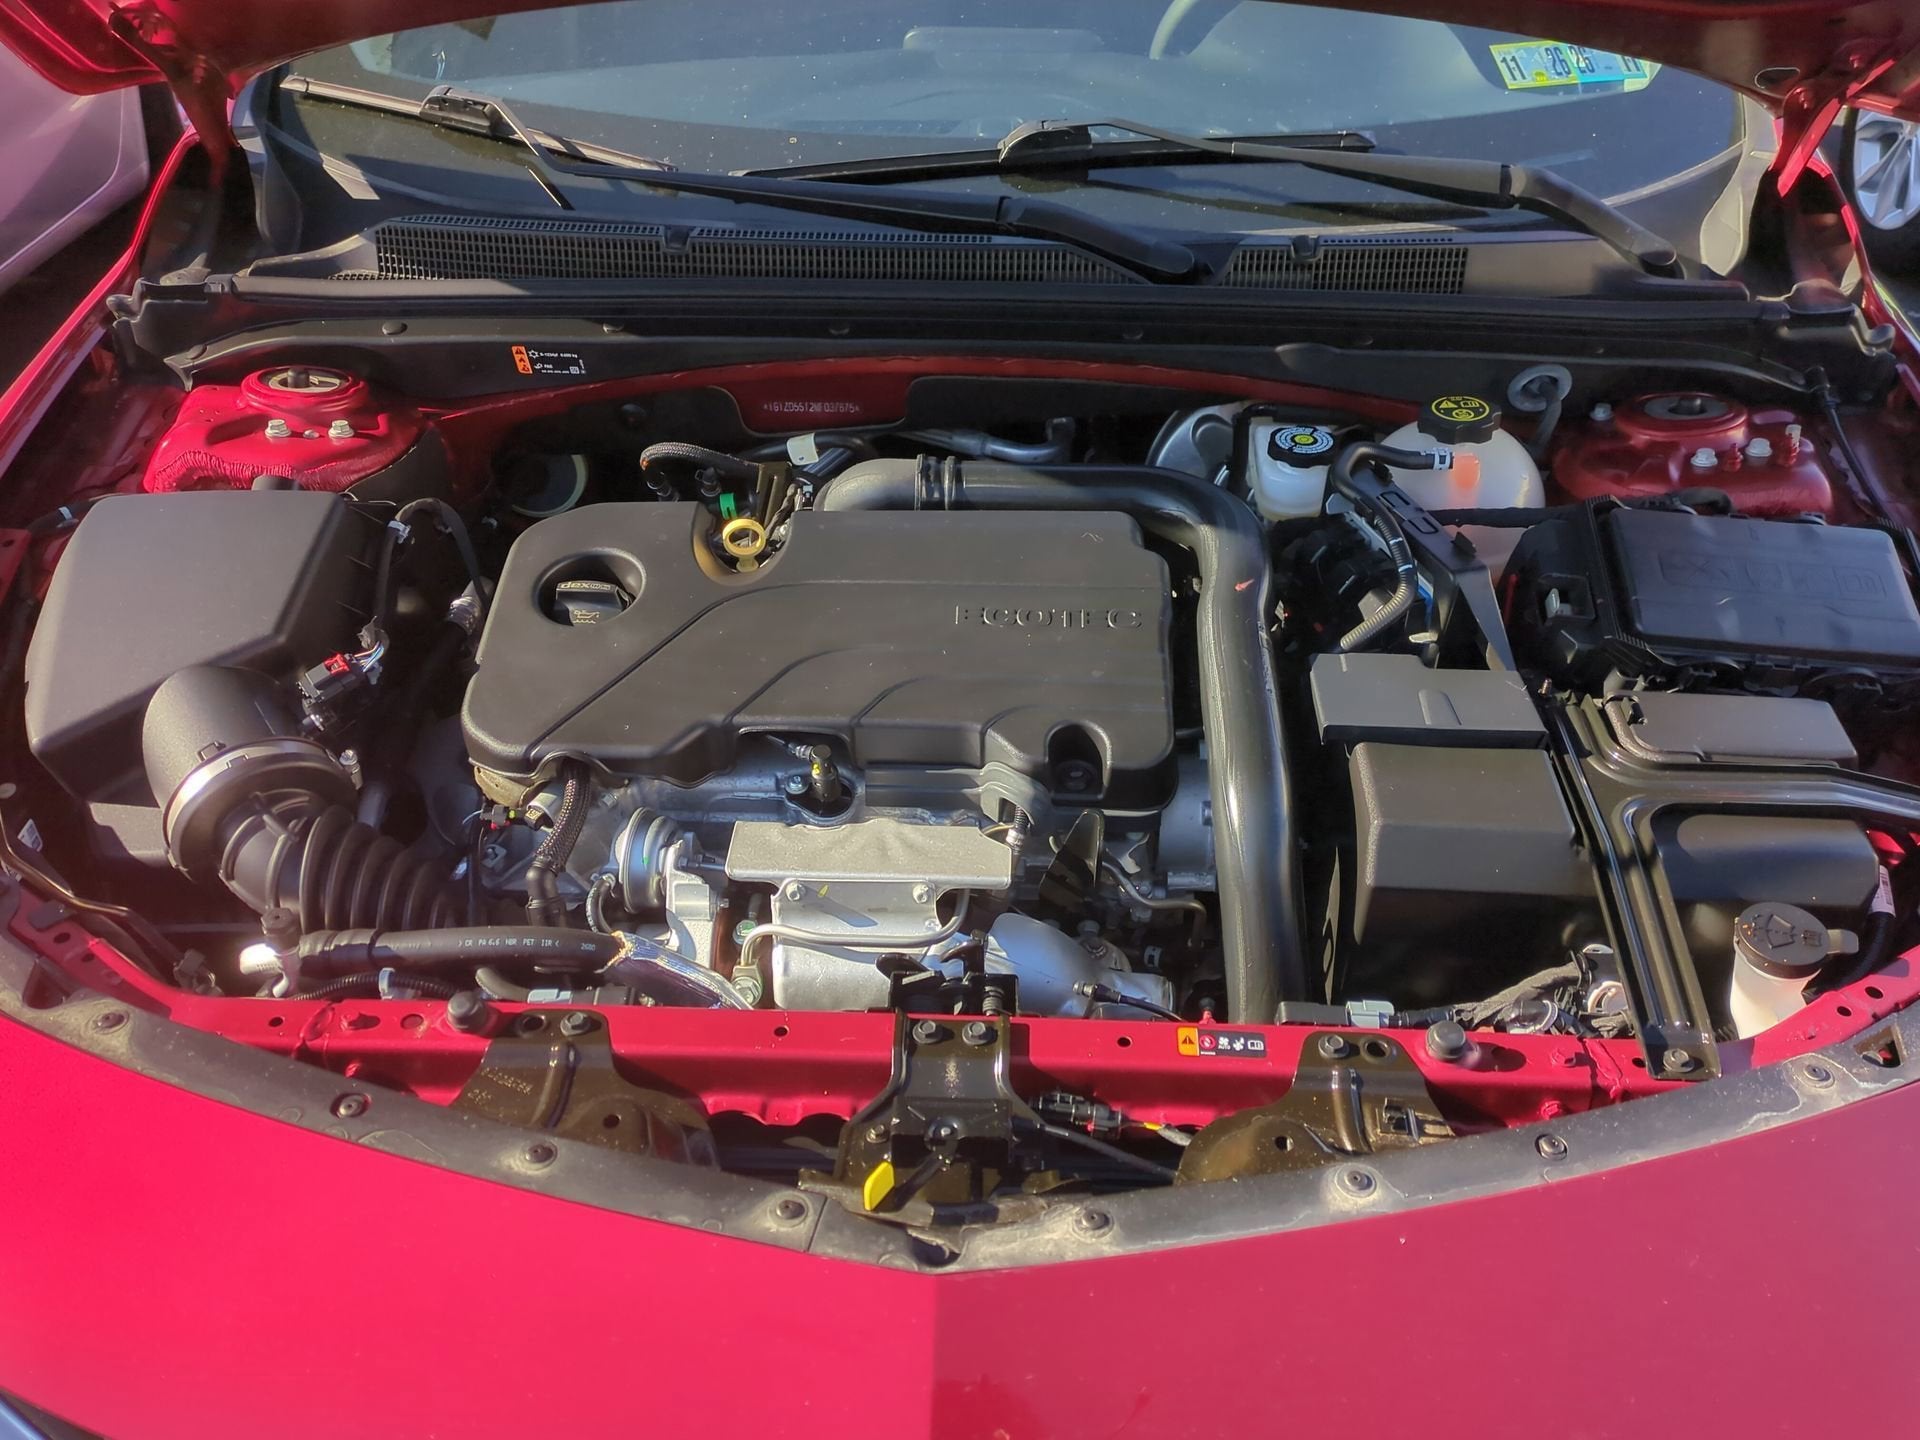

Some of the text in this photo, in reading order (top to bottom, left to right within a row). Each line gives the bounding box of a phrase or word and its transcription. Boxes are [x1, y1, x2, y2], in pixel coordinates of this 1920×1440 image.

[1500, 47, 1571, 81] 11 26
[955, 606, 1143, 629] ECOTEC
